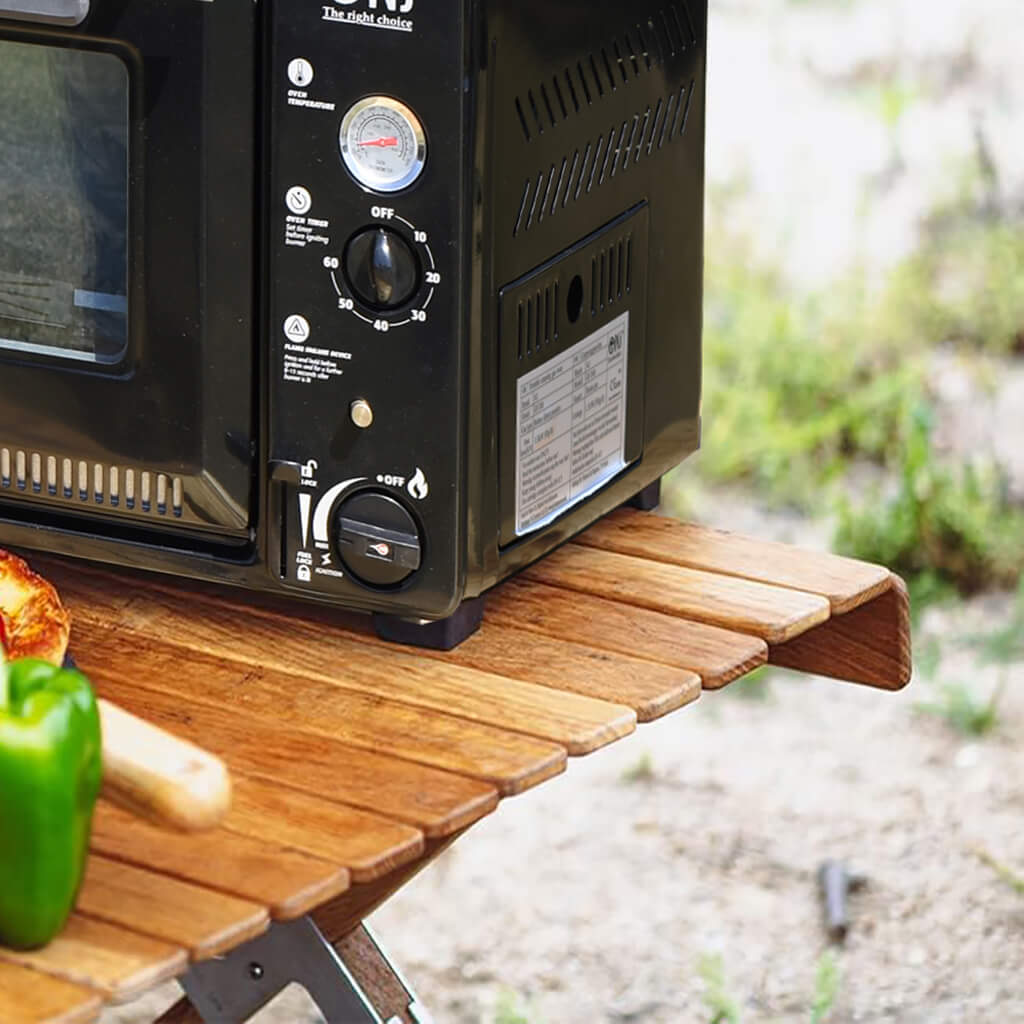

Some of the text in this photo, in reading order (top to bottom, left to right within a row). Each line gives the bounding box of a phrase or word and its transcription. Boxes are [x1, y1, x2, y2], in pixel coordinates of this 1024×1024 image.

[322, 6, 413, 29] The right choice
[370, 206, 395, 220] OFF
[413, 230, 427, 243] 10
[323, 256, 339, 269] 60
[425, 271, 440, 284] 20
[338, 298, 354, 310] 50
[411, 309, 426, 322] 30
[373, 320, 389, 332] 40
[384, 474, 406, 487] OFF
